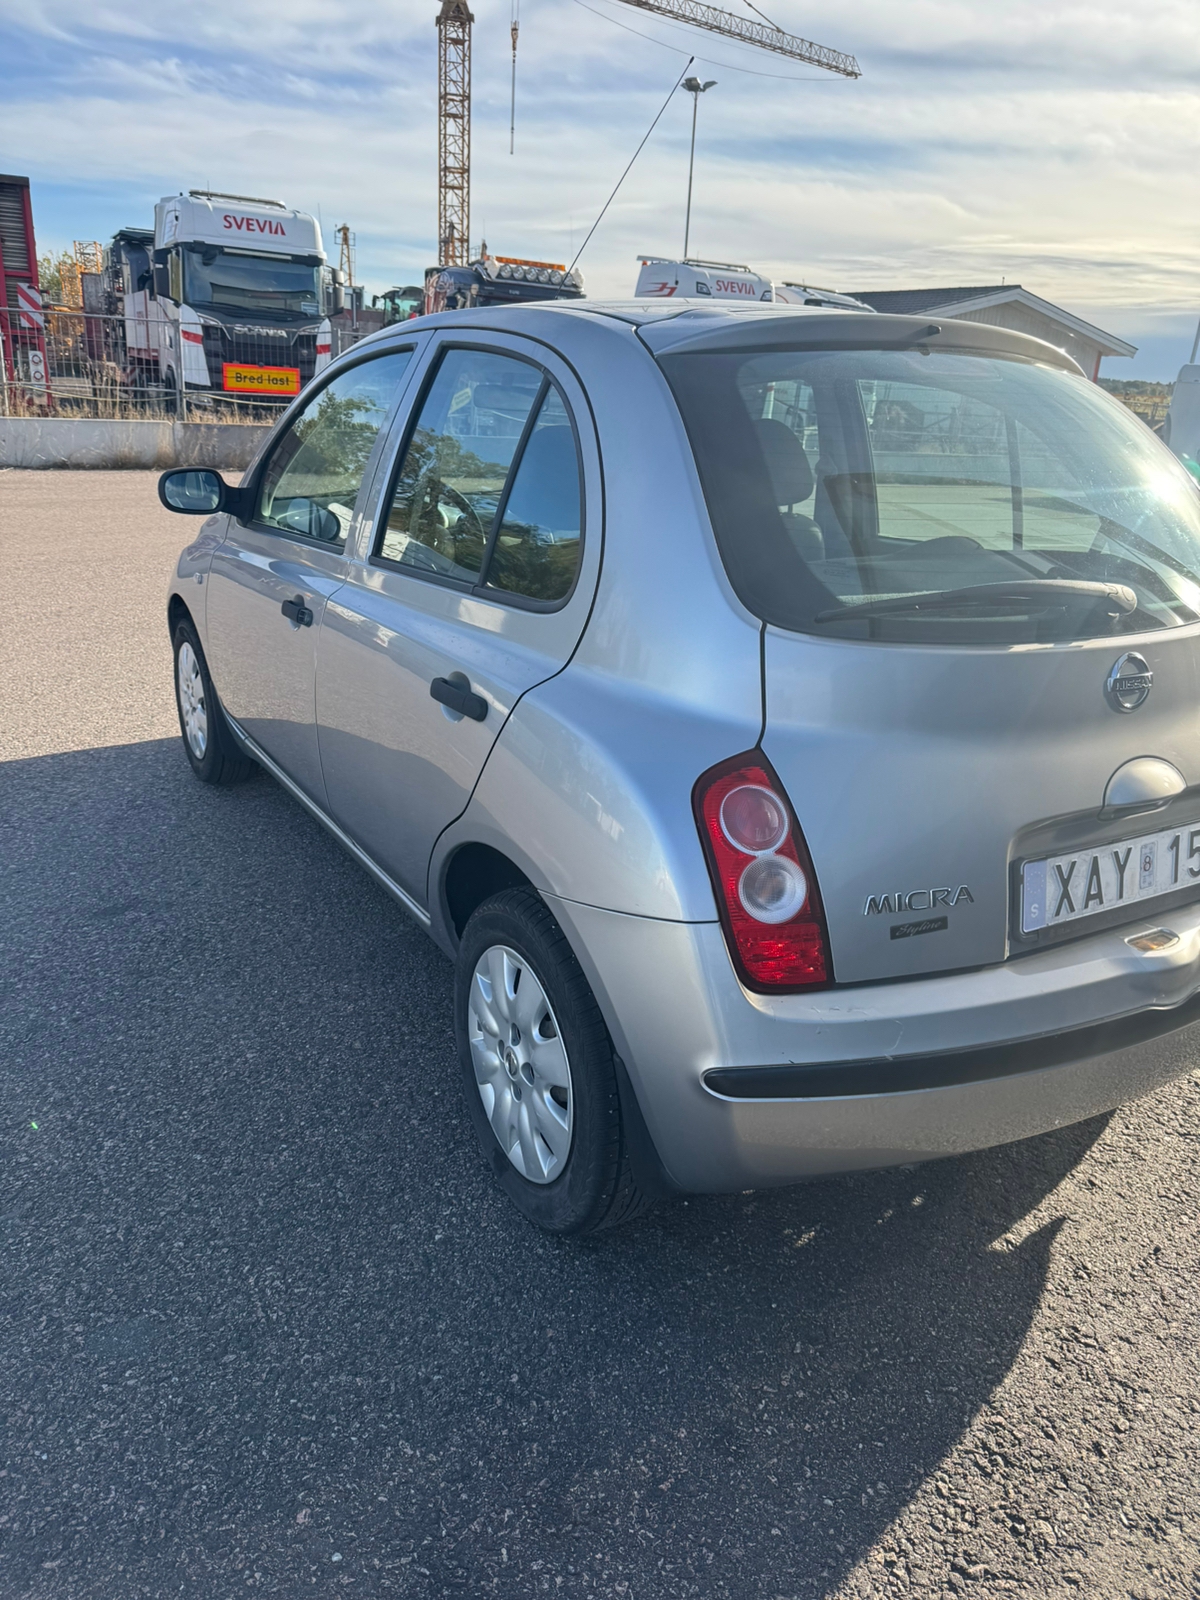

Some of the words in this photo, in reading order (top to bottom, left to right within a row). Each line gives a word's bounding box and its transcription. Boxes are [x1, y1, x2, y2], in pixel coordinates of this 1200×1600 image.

[223, 214, 287, 236] SVEVIA
[715, 279, 756, 296] SVEVIA
[235, 372, 264, 385] Bred
[267, 374, 290, 386] last
[1030, 903, 1040, 919] S
[1054, 846, 1133, 918] XAY
[863, 884, 975, 916] MICRA
[895, 920, 944, 937] Styline
